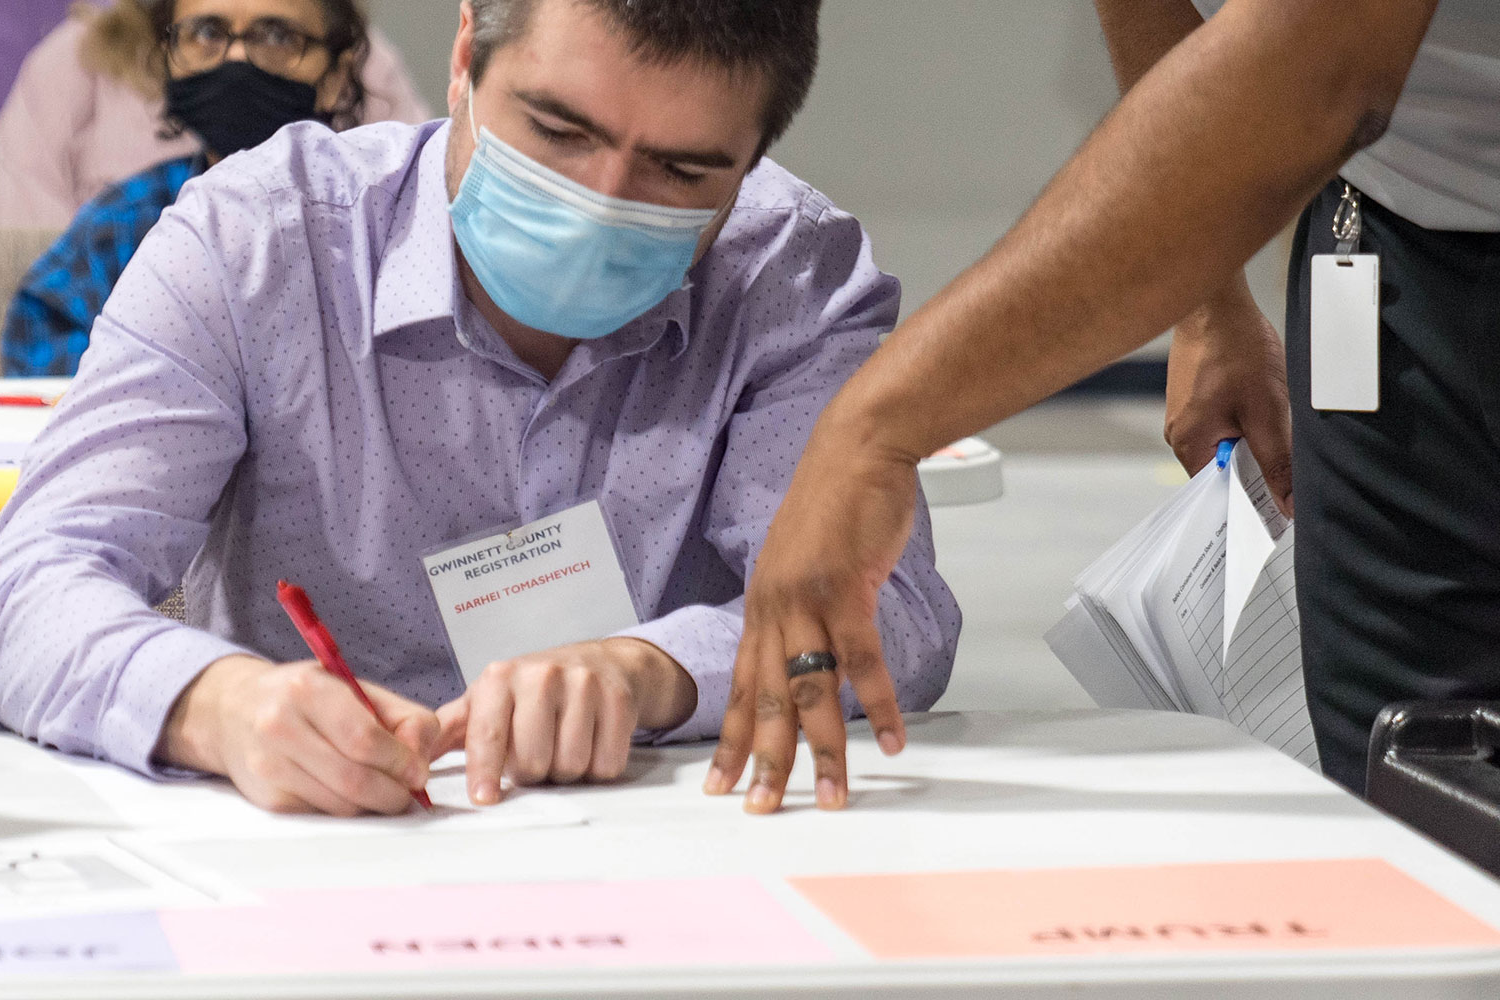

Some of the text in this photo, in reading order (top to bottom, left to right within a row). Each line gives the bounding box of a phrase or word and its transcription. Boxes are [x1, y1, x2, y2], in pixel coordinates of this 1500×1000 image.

[428, 544, 503, 577] GWINNETT
[464, 539, 563, 581] REGISTRATION
[454, 560, 591, 614] SIARHEI TOMASHEVICH
[369, 933, 627, 955] BIDEN
[1031, 919, 1327, 944] TRUMP
